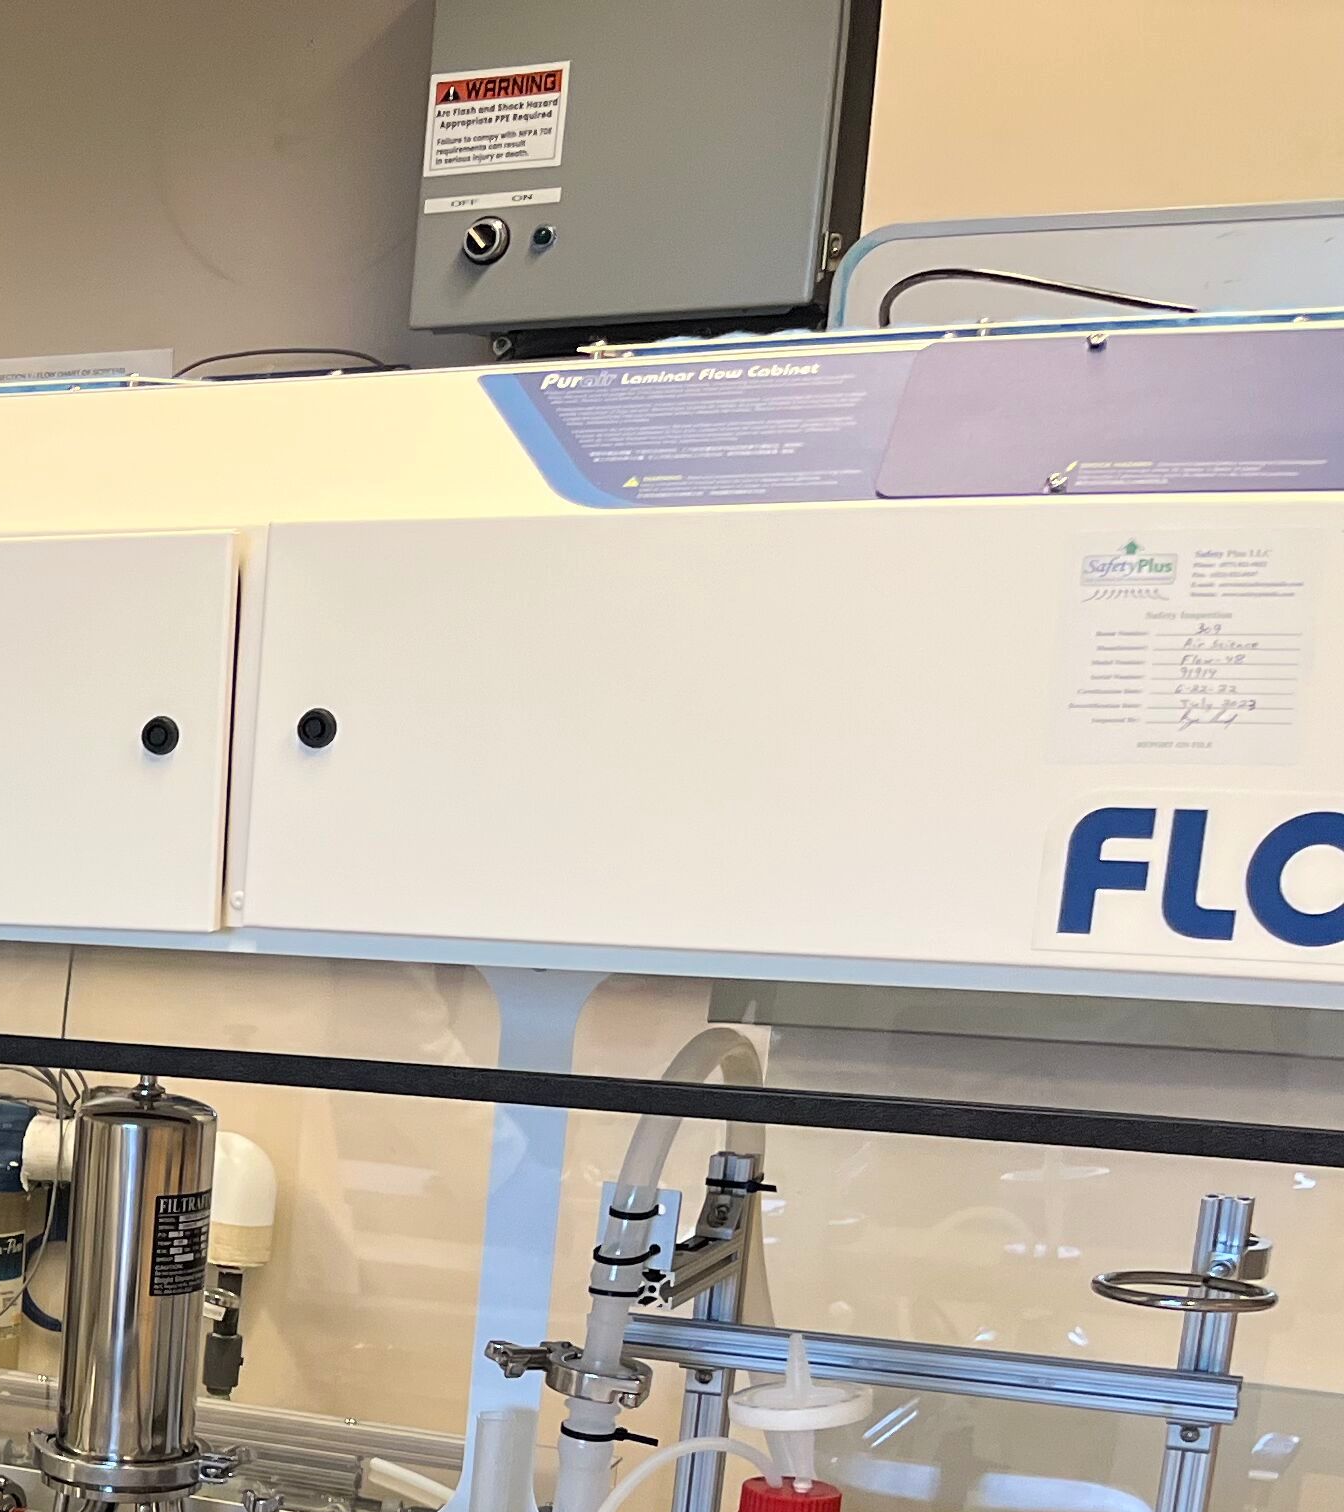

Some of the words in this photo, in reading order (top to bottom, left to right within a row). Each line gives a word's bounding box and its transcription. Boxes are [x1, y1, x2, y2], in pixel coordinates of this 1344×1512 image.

[466, 73, 556, 99] WARNING
[436, 109, 450, 118] Arc
[453, 107, 476, 116] Flash
[478, 104, 495, 114] and
[498, 101, 523, 112] Shock
[526, 98, 558, 109] Hazard
[440, 117, 492, 130] Appropriate
[495, 114, 510, 123] PPE
[512, 110, 552, 122] Required
[621, 371, 695, 385] Laminar
[698, 368, 743, 381] Flow
[748, 363, 822, 378] Cabinet
[1195, 550, 1223, 559] Safety
[1227, 550, 1247, 558] Plus
[1250, 550, 1271, 558] LLC
[1146, 611, 1176, 620] Safety
[1180, 611, 1232, 620] Inspection
[1196, 623, 1222, 635] 309
[1183, 640, 1204, 650] Air
[1180, 697, 1213, 711] July
